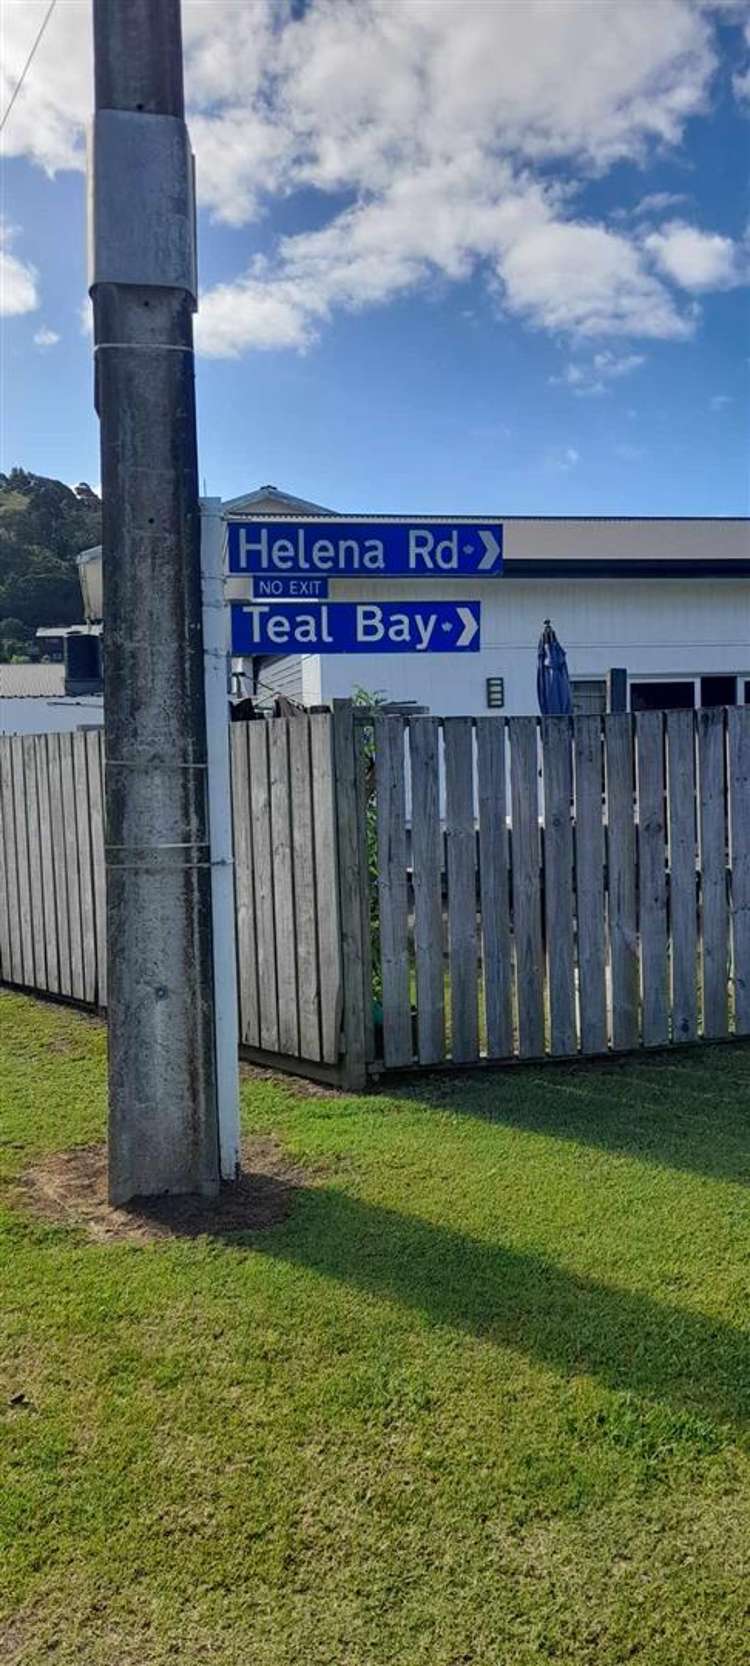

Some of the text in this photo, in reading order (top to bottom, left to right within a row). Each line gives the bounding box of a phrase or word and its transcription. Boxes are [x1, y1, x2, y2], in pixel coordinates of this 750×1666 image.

[238, 528, 458, 569] Helena Rd
[259, 581, 321, 595] NO EXIT
[242, 605, 437, 650] Teal Bay
